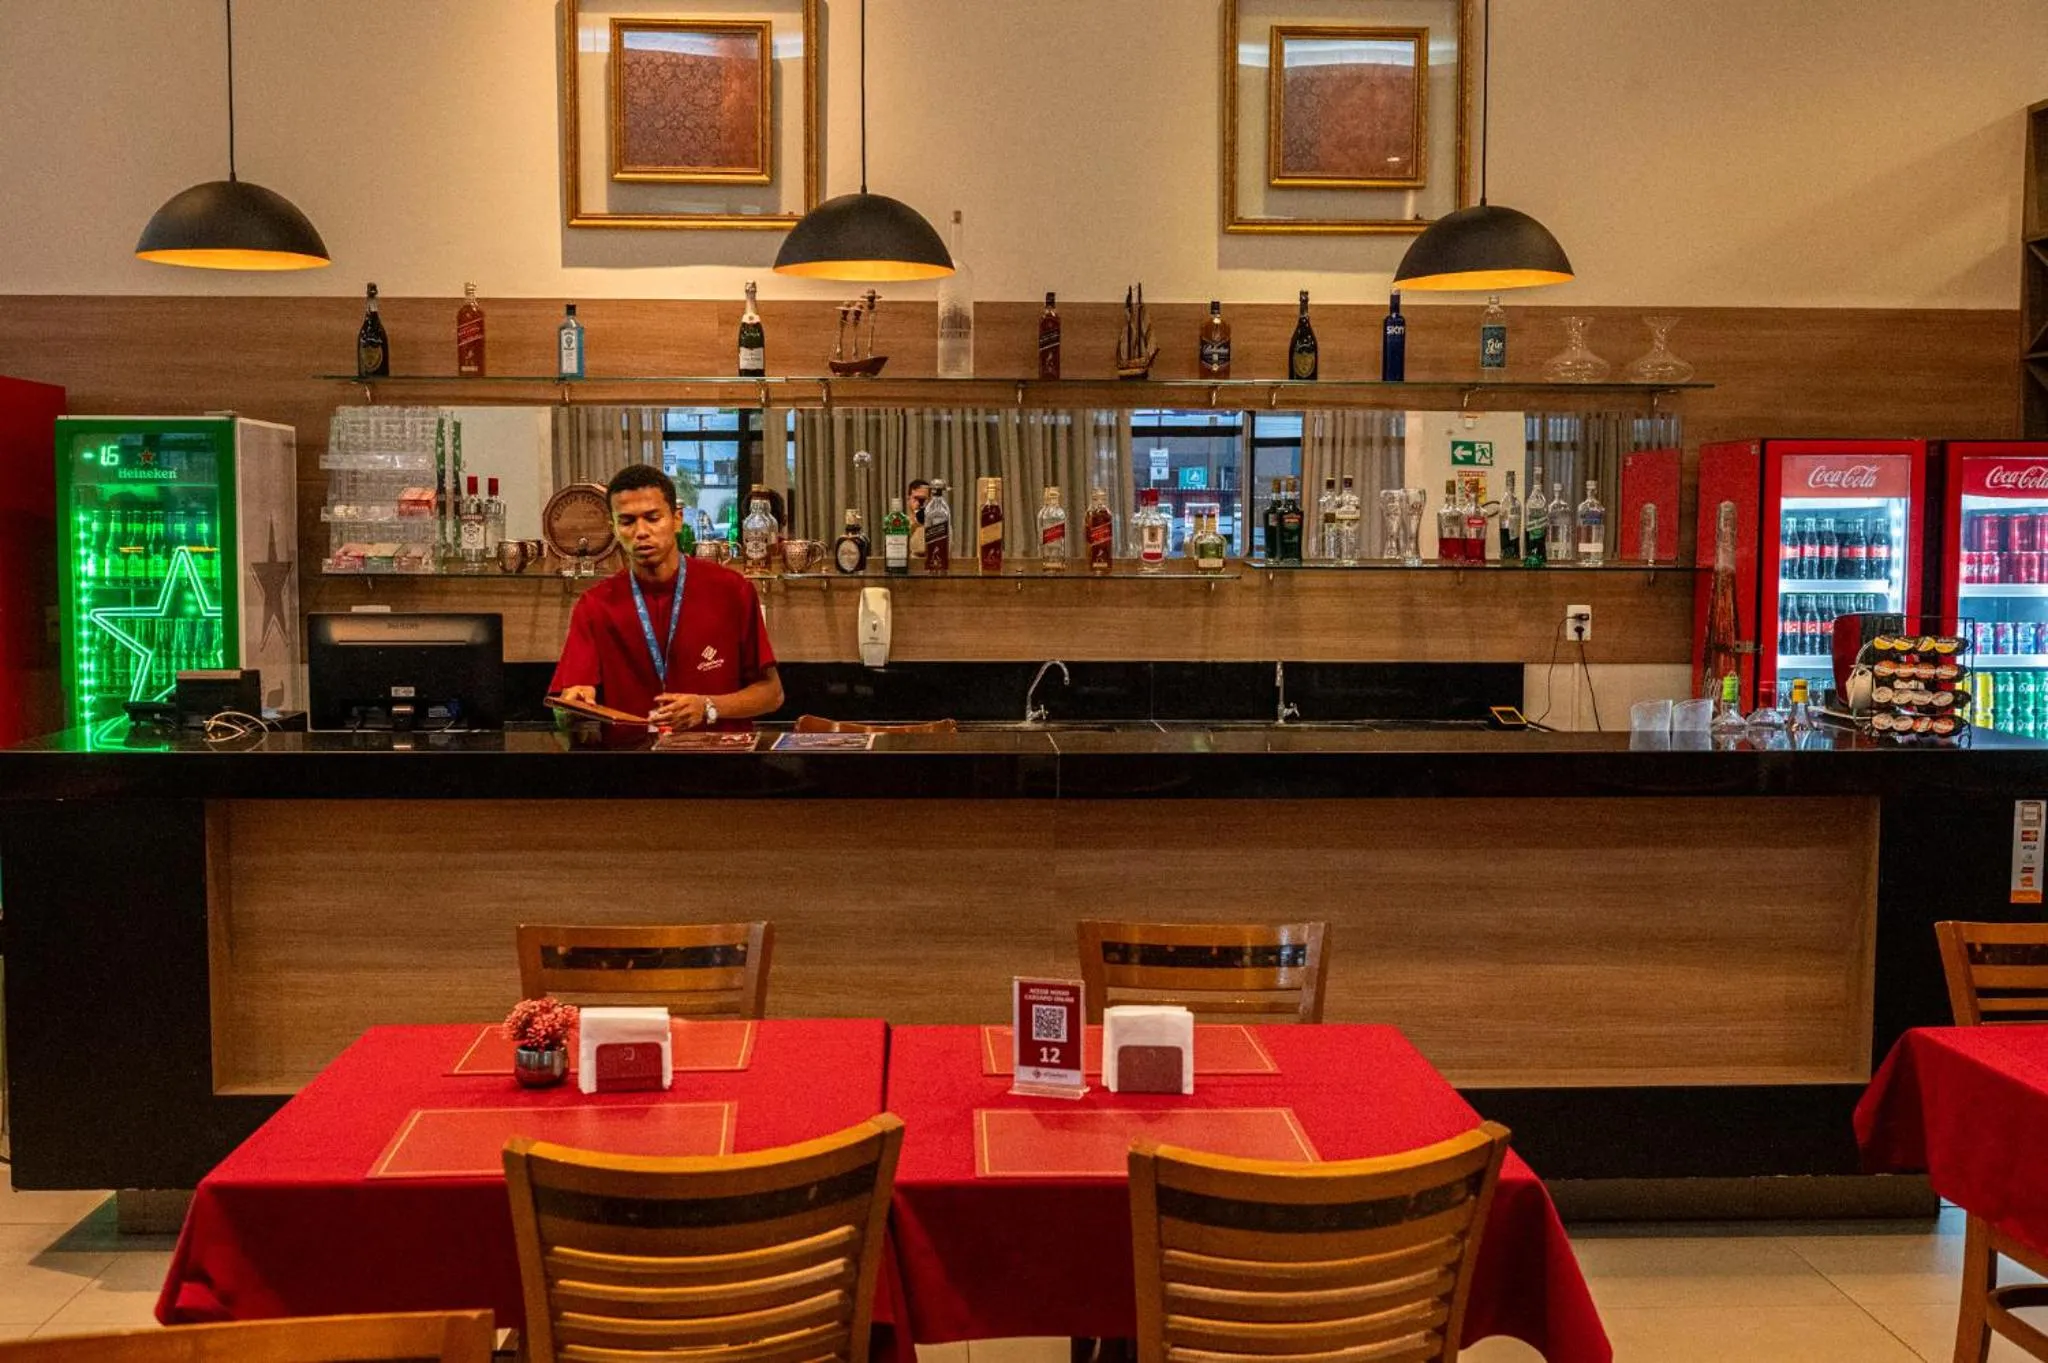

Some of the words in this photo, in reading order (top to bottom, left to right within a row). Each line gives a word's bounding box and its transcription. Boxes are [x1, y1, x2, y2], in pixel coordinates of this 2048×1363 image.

[118, 468, 177, 478] Heineken
[1808, 465, 1880, 488] Coca-Cola
[1040, 1047, 1061, 1064] 12
